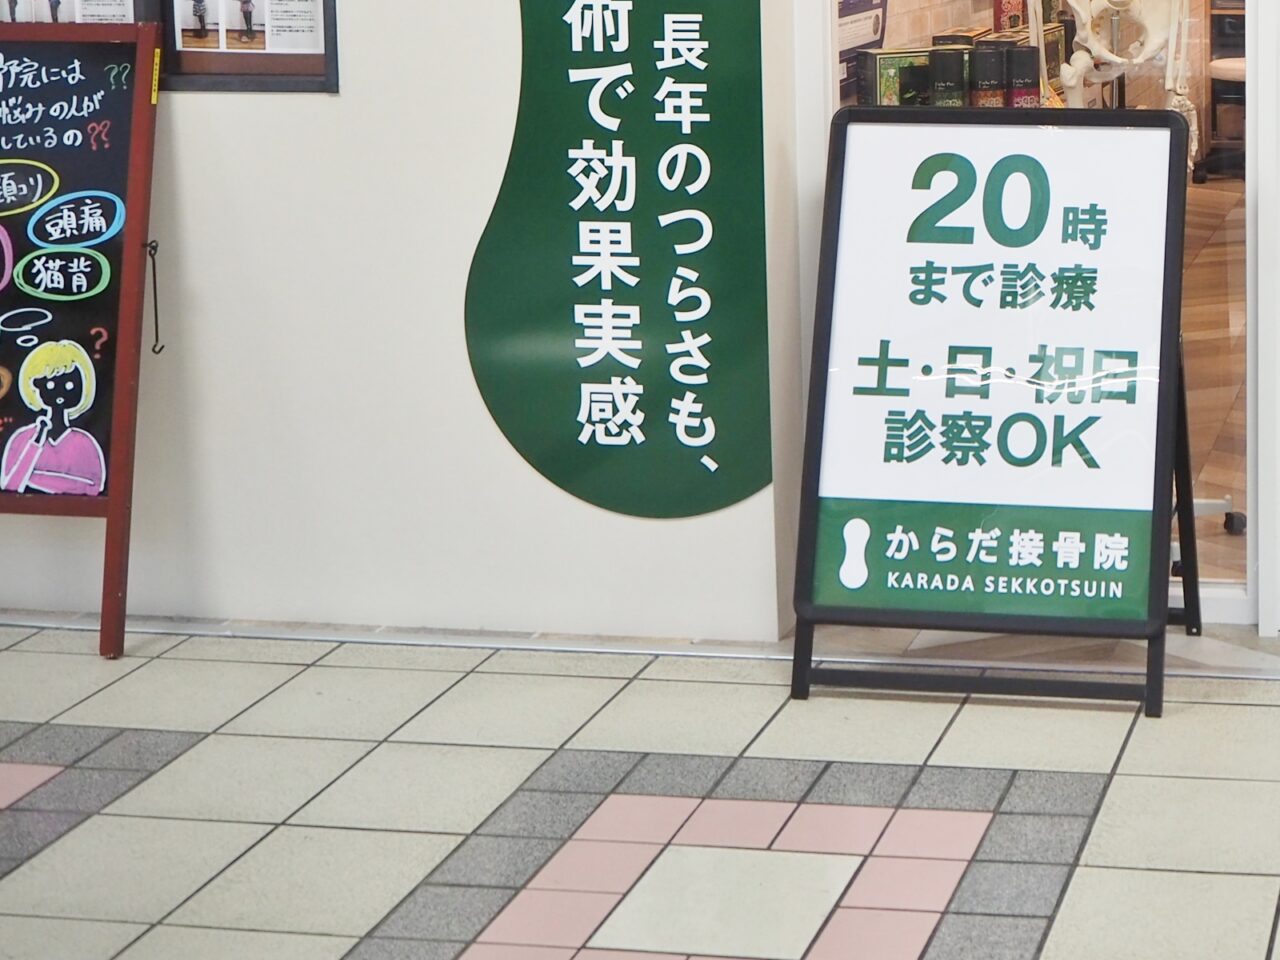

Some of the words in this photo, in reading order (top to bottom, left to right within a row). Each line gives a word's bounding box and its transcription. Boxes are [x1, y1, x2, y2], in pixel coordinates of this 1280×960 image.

[0, 52, 86, 92] 院には
[44, 199, 107, 240] 頭痛
[906, 152, 1108, 250] 20時
[31, 256, 92, 293] 猫背
[908, 260, 1098, 311] まで診療
[852, 339, 1139, 405] 土・日・祝日
[883, 410, 1102, 469] 診察OK
[884, 525, 1130, 571] からだ接骨院
[887, 571, 975, 593] KARADA
[984, 574, 1124, 599] SEKKOTSUIN
